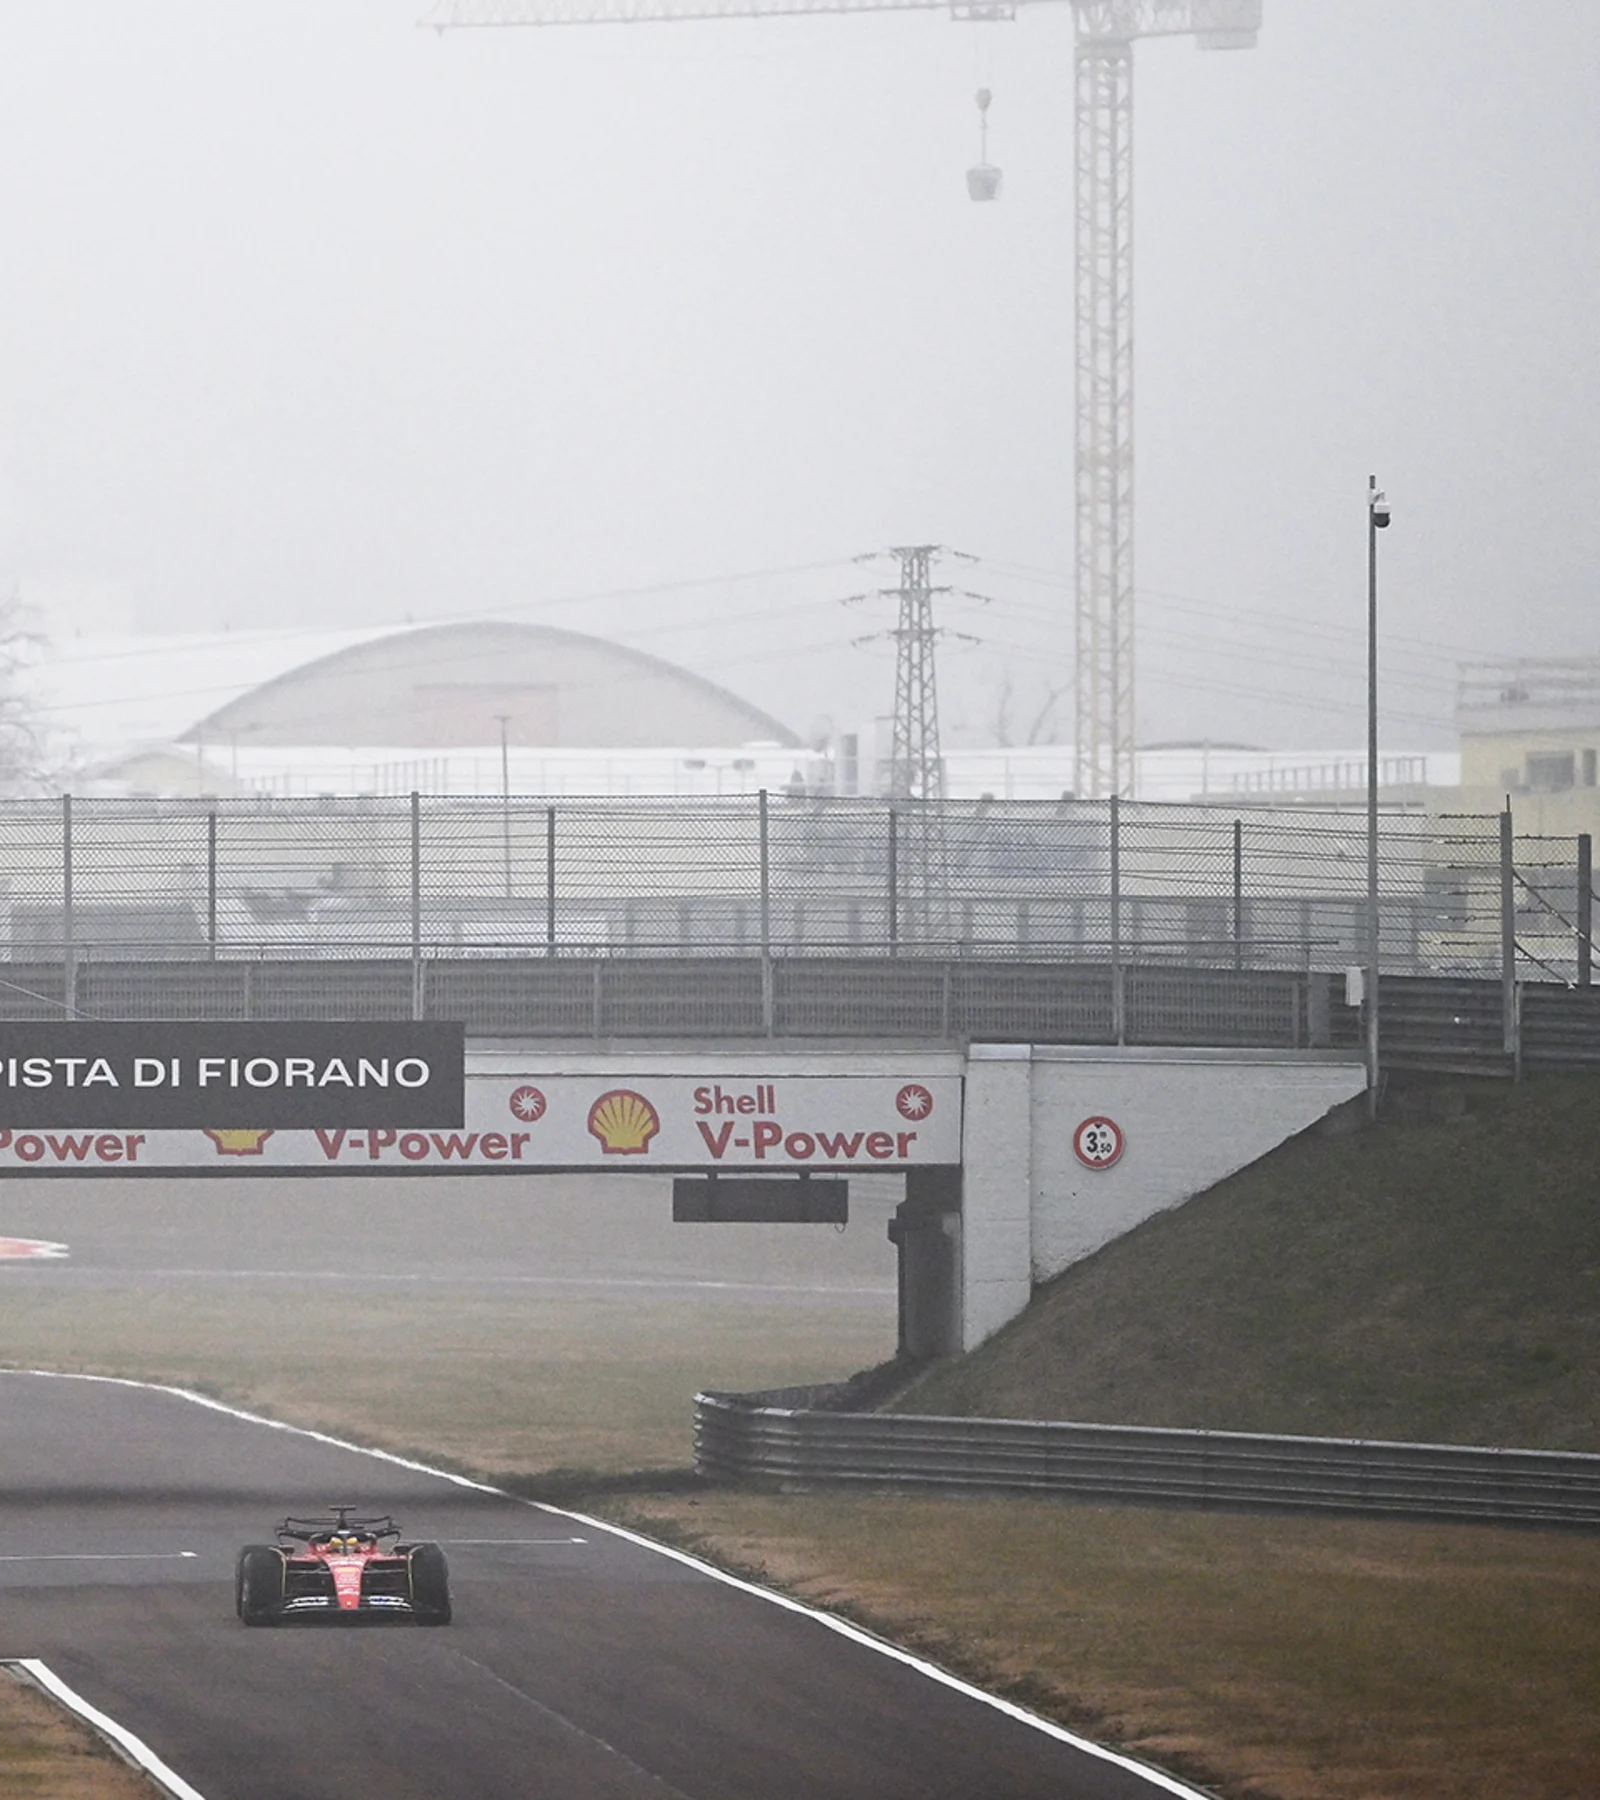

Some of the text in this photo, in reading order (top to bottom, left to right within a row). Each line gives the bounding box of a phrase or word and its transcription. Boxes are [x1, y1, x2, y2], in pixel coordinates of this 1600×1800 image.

[134, 1058, 180, 1087] DI
[198, 1058, 430, 1088] FIORANO
[693, 1085, 775, 1114] Shell
[314, 1128, 530, 1160] V-Power
[696, 1121, 917, 1159] V-Power
